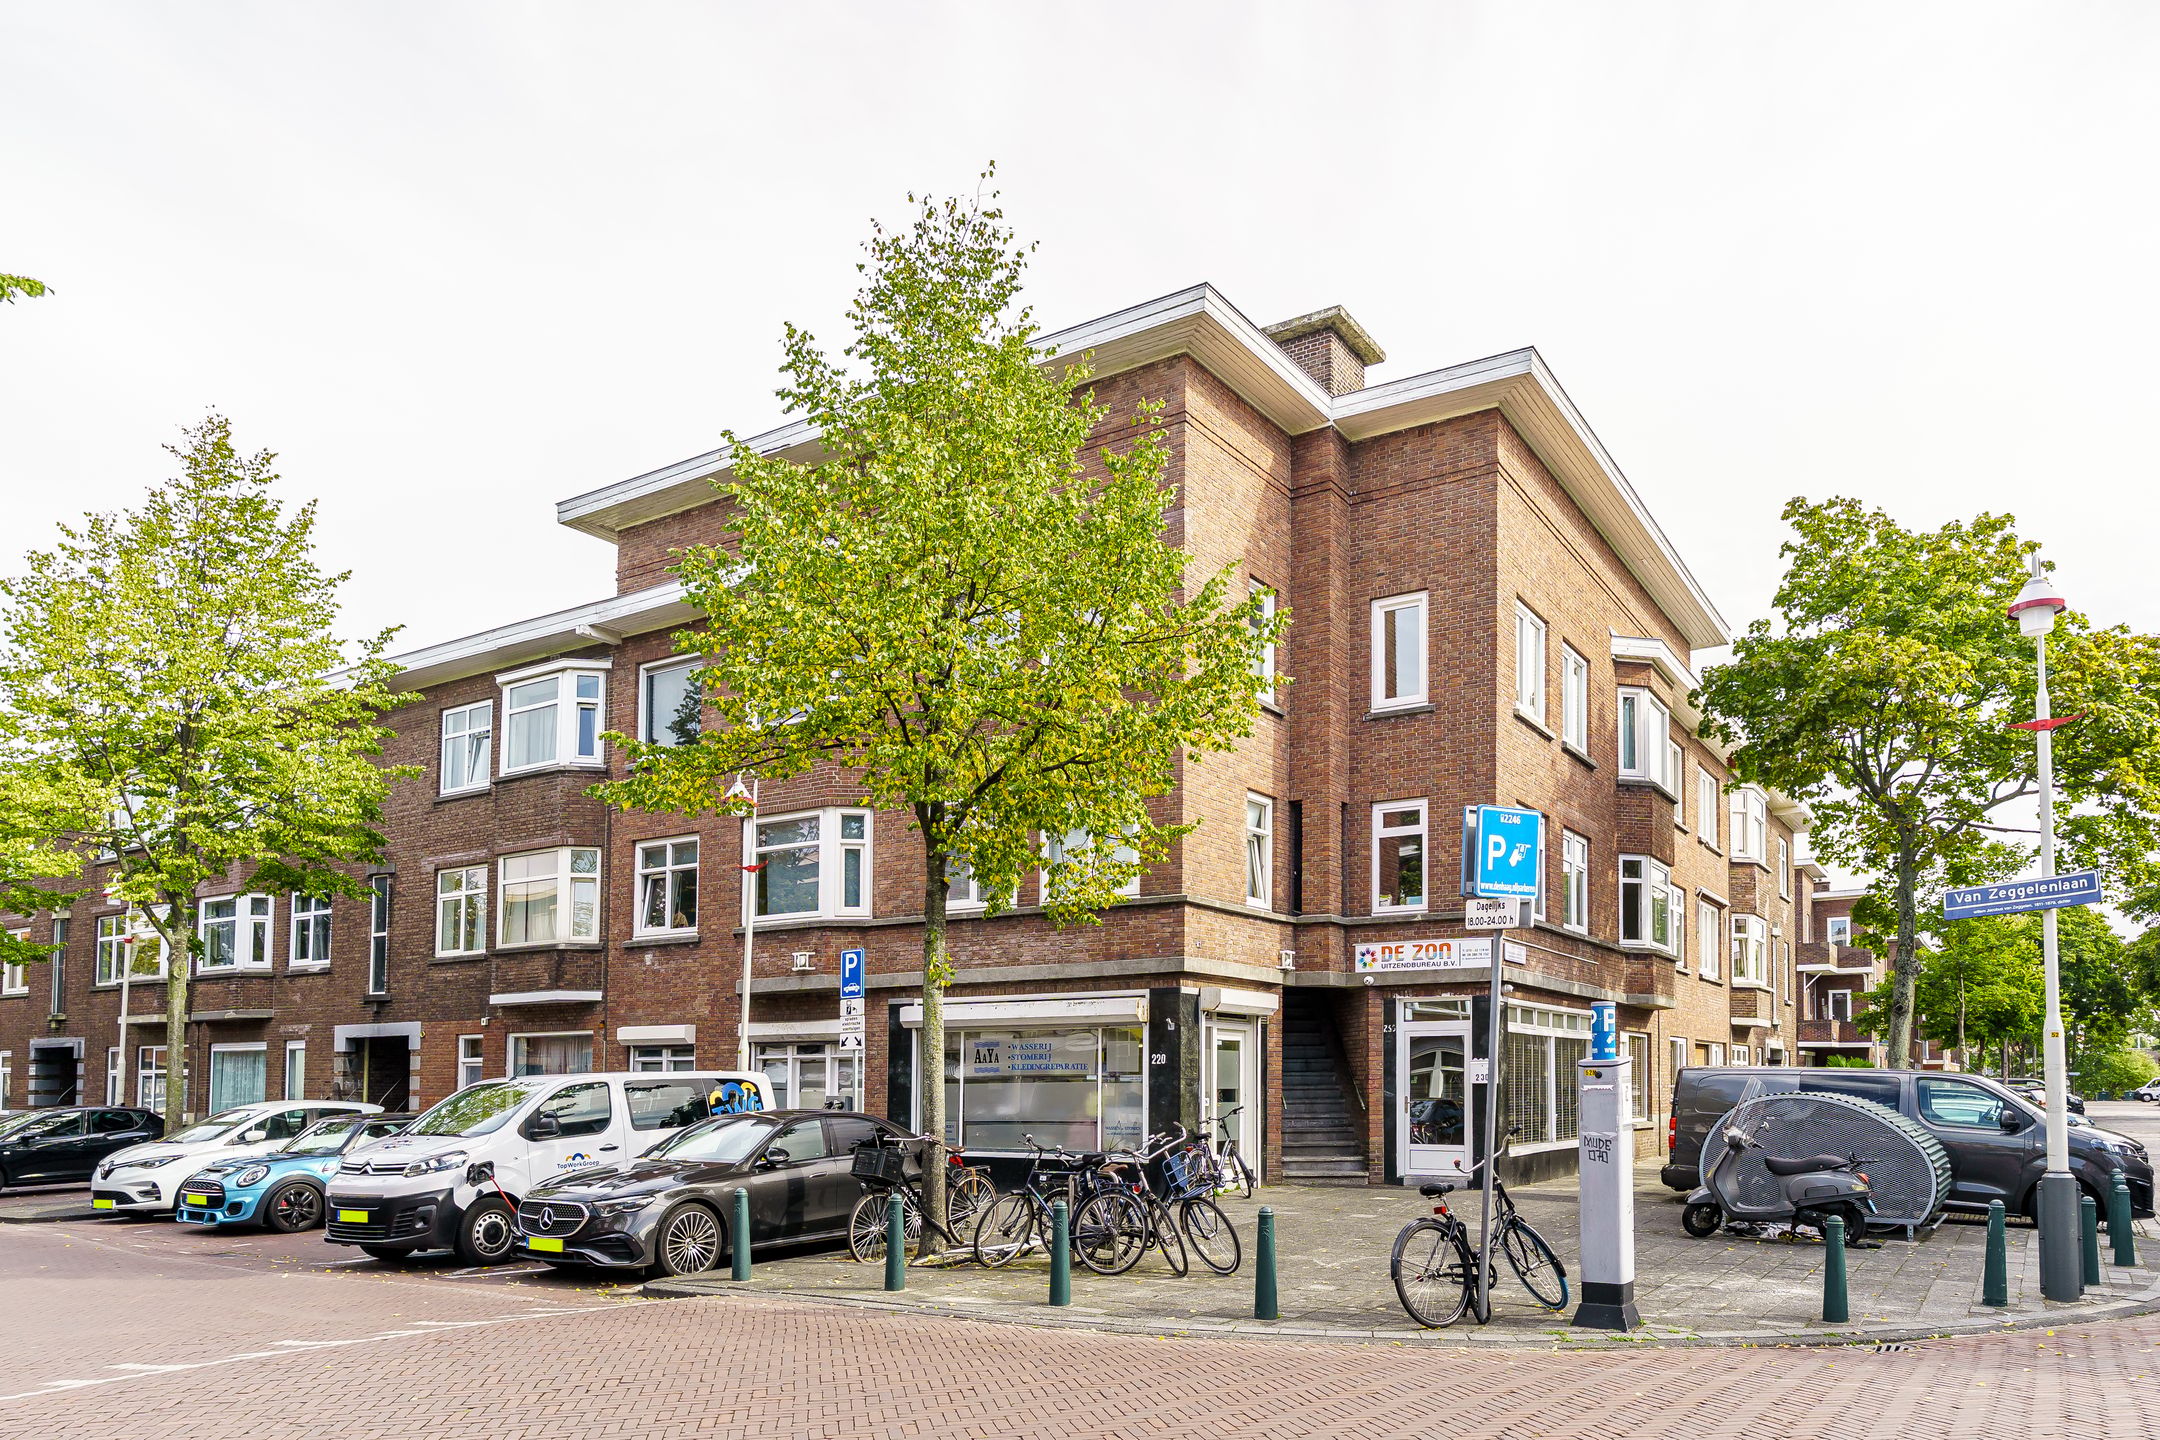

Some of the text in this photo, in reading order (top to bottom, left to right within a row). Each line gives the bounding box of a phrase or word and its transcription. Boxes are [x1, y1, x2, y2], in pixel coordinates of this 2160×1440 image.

[1487, 834, 1507, 871] P
[1954, 878, 2088, 904] Van Zeggelenlaan
[1476, 902, 1506, 913] Dagelijks
[1467, 915, 1514, 926] 18.00-24.00 h
[1381, 944, 1405, 962] DE
[1412, 942, 1452, 961] ZON
[845, 953, 858, 978] P
[1381, 961, 1442, 970] UITZENDBUREAU
[1011, 1043, 1052, 1052] WASSERIJ
[1011, 1053, 1052, 1062] STOMERIJ
[1151, 1054, 1166, 1064] 220
[1011, 1063, 1088, 1071] KLEDINGREPARATIE
